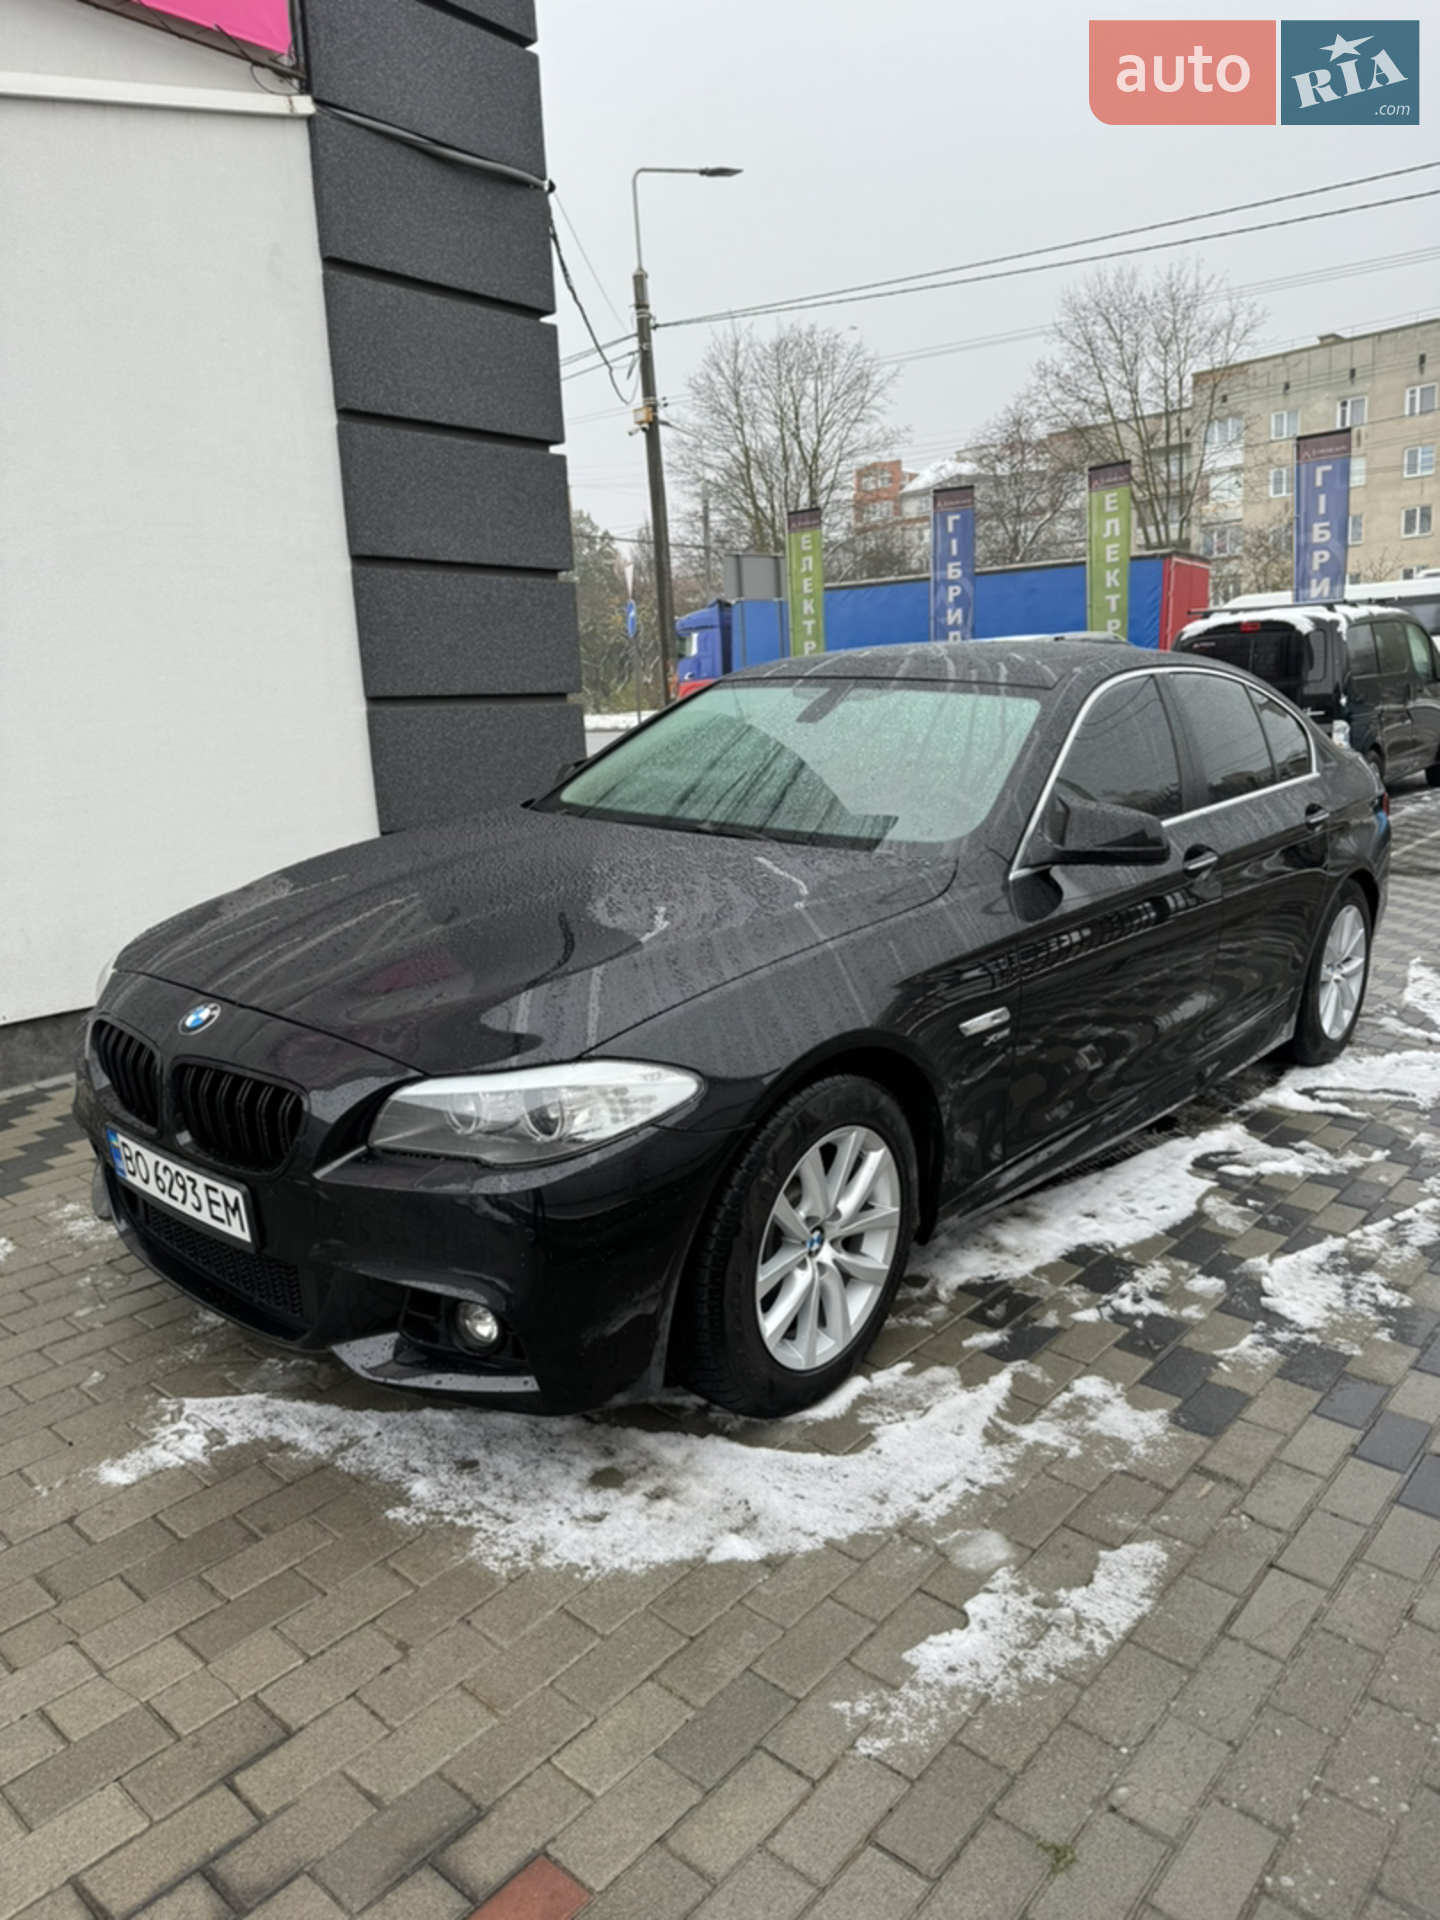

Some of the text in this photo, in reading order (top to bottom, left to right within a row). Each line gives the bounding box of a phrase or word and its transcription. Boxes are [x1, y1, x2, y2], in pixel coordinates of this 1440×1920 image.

[121, 1142, 246, 1233] BO 6293 EM
